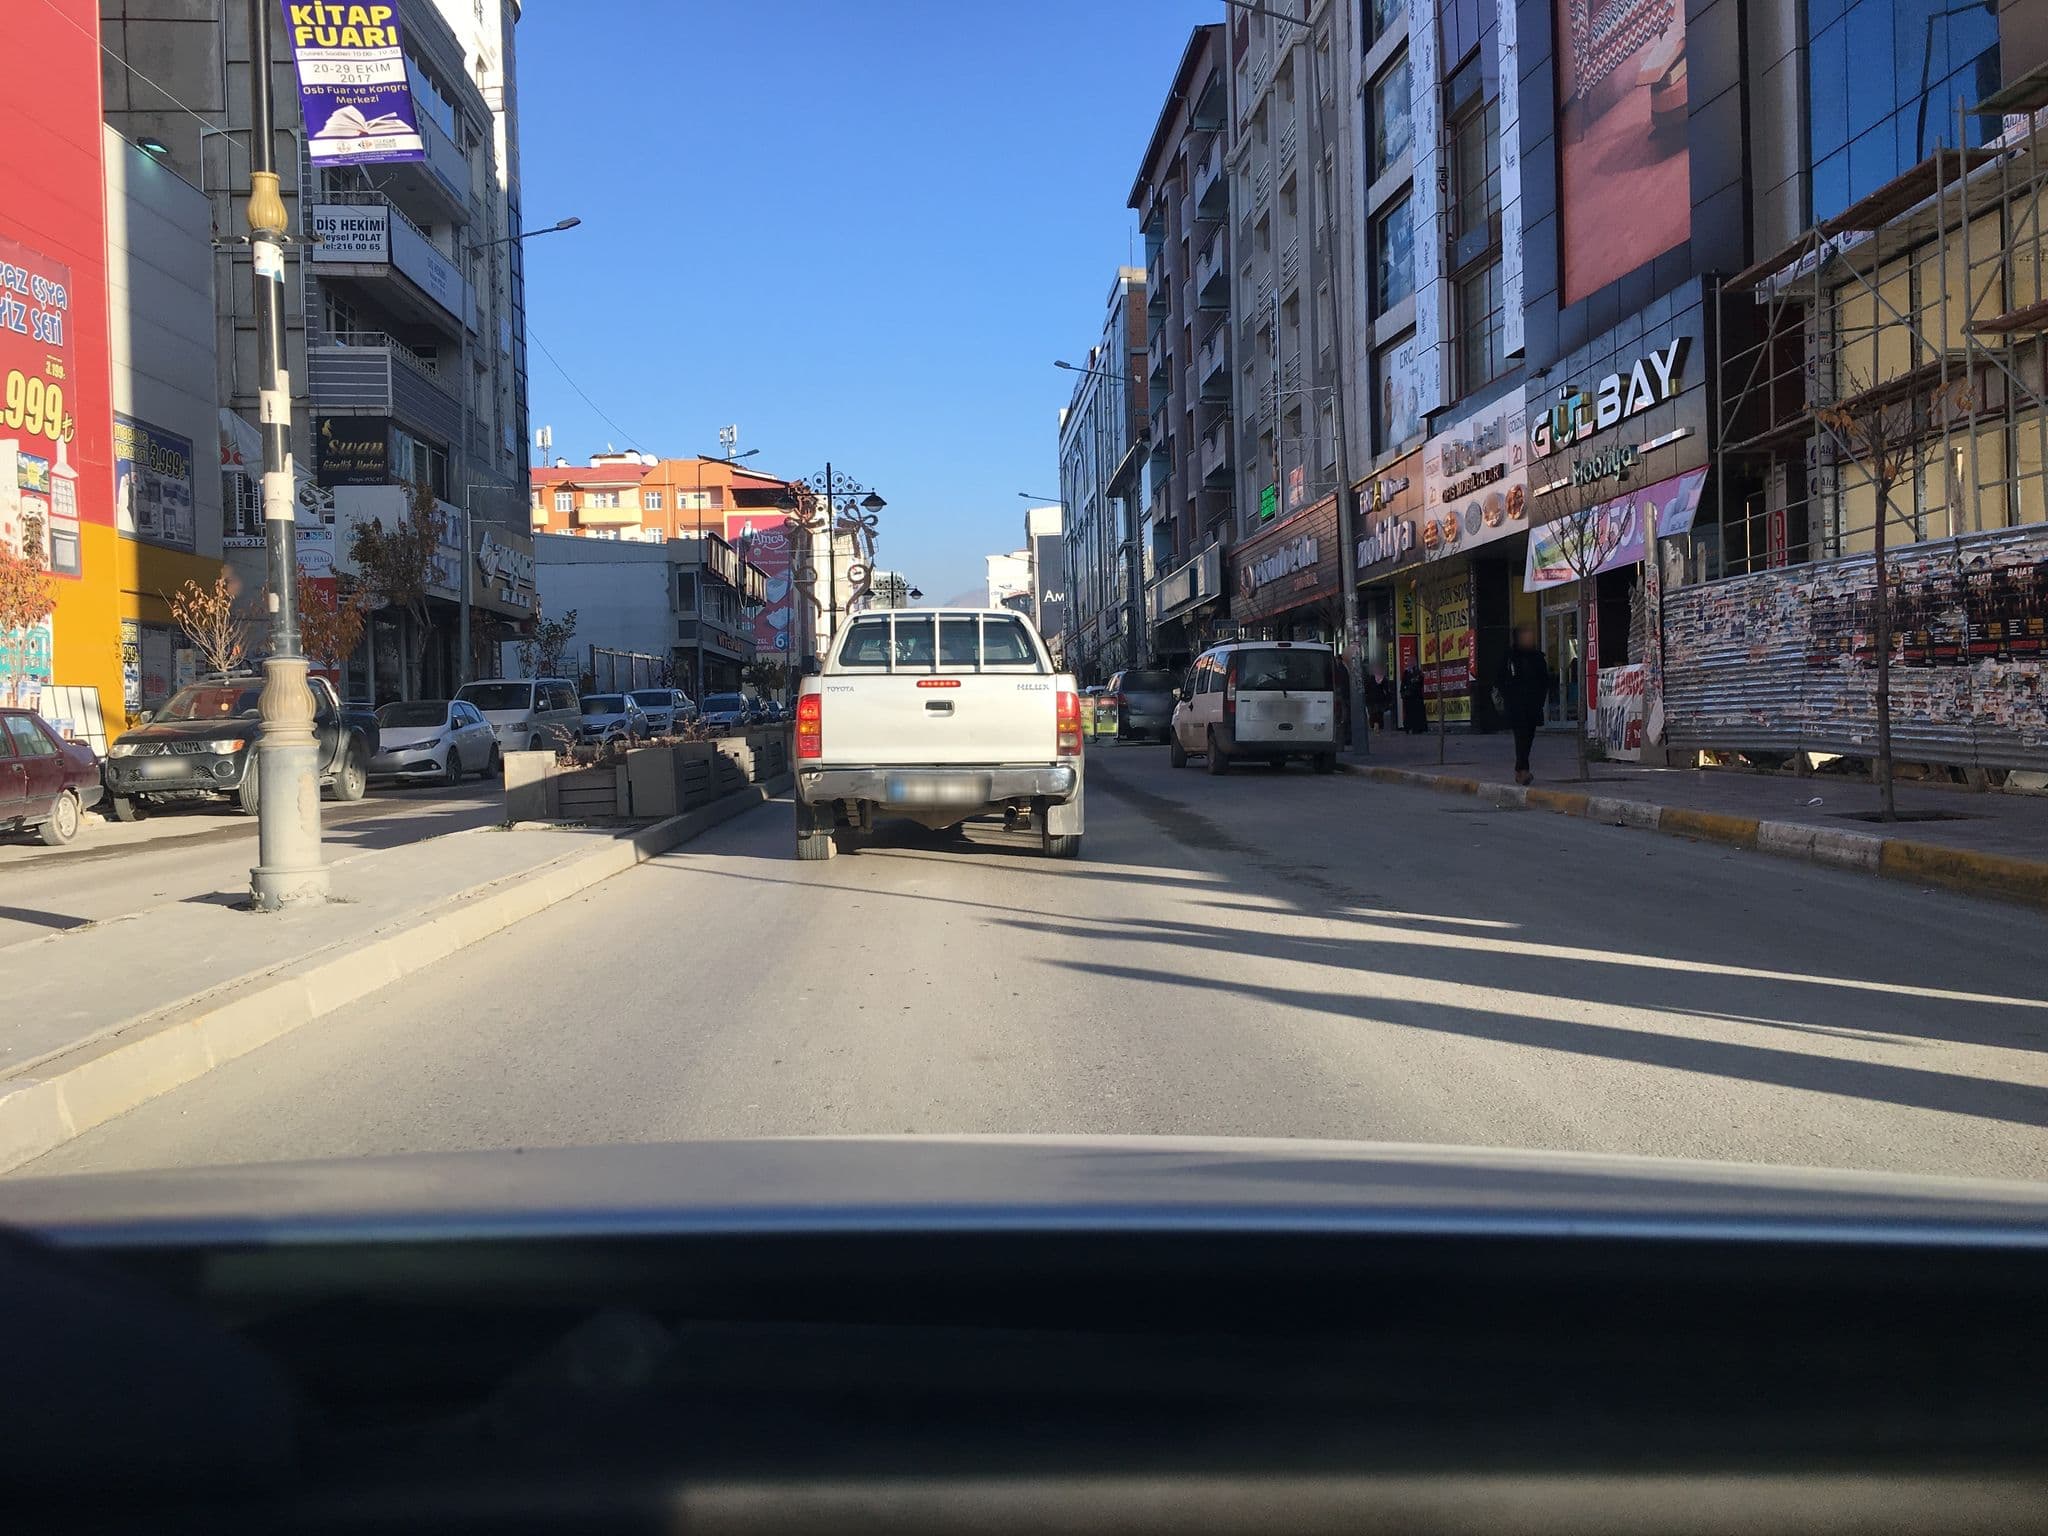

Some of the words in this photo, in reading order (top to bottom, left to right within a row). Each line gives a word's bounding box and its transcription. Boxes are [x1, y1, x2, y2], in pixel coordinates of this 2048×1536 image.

[290, 1, 392, 26] KİTAP
[294, 26, 398, 47] FUARI
[313, 63, 351, 73] 20-29
[356, 62, 392, 73] EKİM
[340, 73, 371, 83] 2017
[303, 86, 325, 95] Osb
[327, 86, 350, 95] Fuar
[353, 87, 366, 95] ve
[369, 84, 408, 95] Kongre
[336, 94, 380, 104] Merkezi
[316, 216, 337, 234] DİŞ
[341, 217, 385, 231] HEKİMİ
[352, 233, 381, 242] POLAT
[31, 274, 67, 310] EŞYA
[31, 307, 63, 347] SETİ
[1358, 515, 1414, 569] mobilya
[1016, 683, 1050, 691] HILUX
